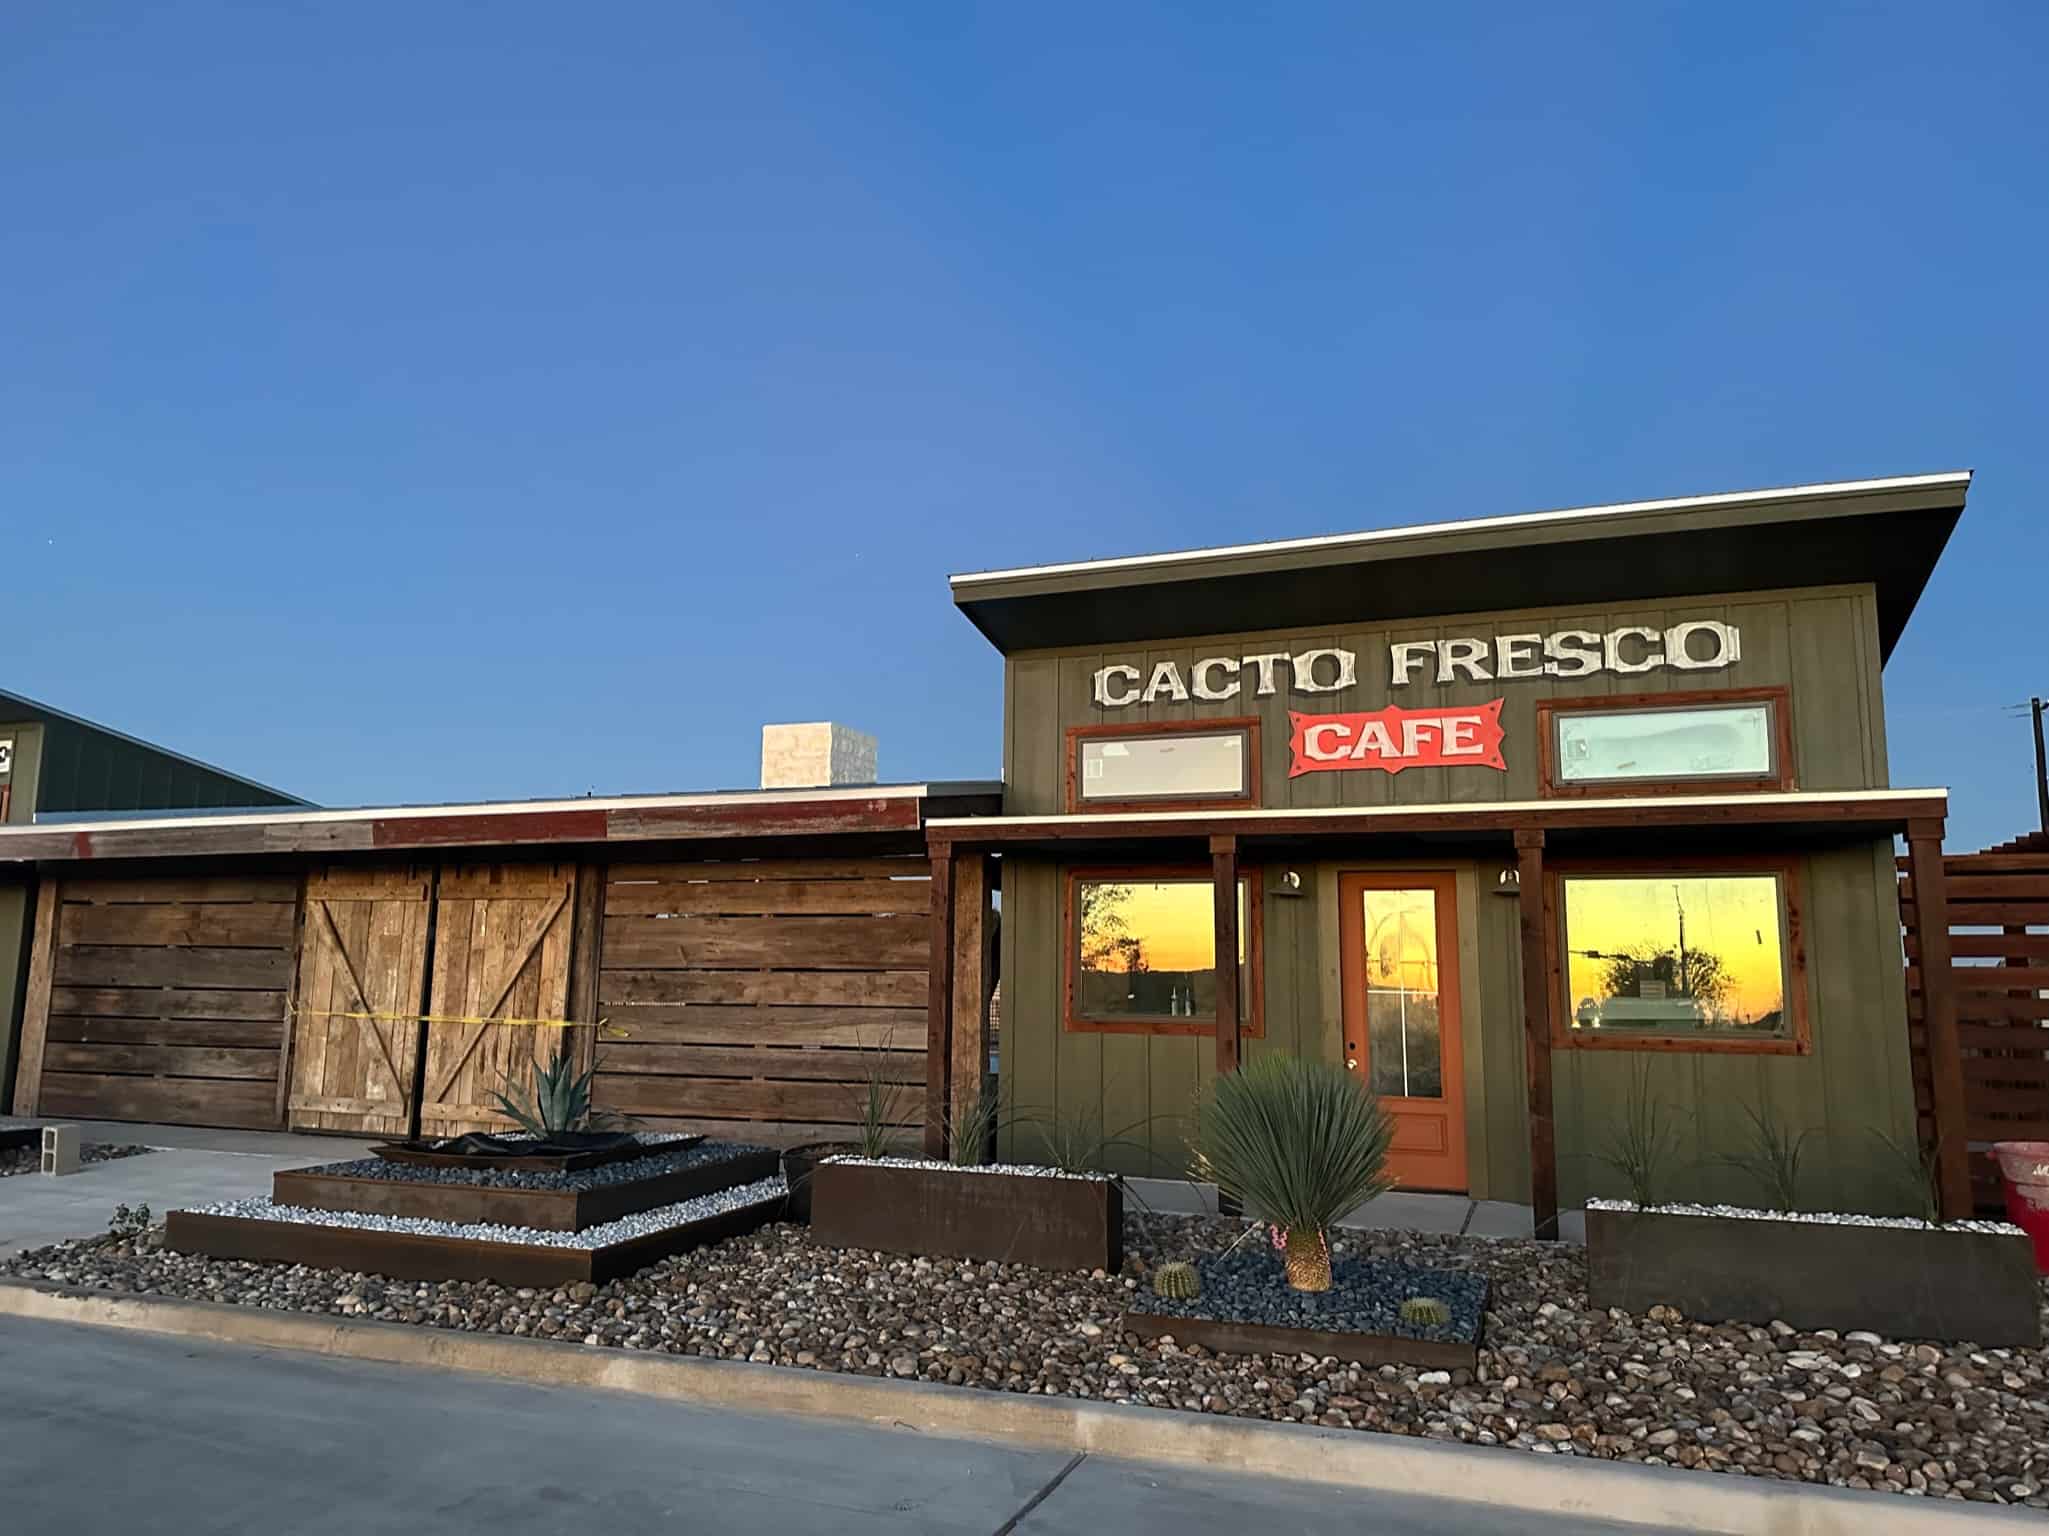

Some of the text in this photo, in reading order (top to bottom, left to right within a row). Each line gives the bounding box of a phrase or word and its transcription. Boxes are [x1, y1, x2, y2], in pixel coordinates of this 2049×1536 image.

[1093, 620, 1741, 706] CACTO FRESCO
[1304, 715, 1484, 761] CAFE
